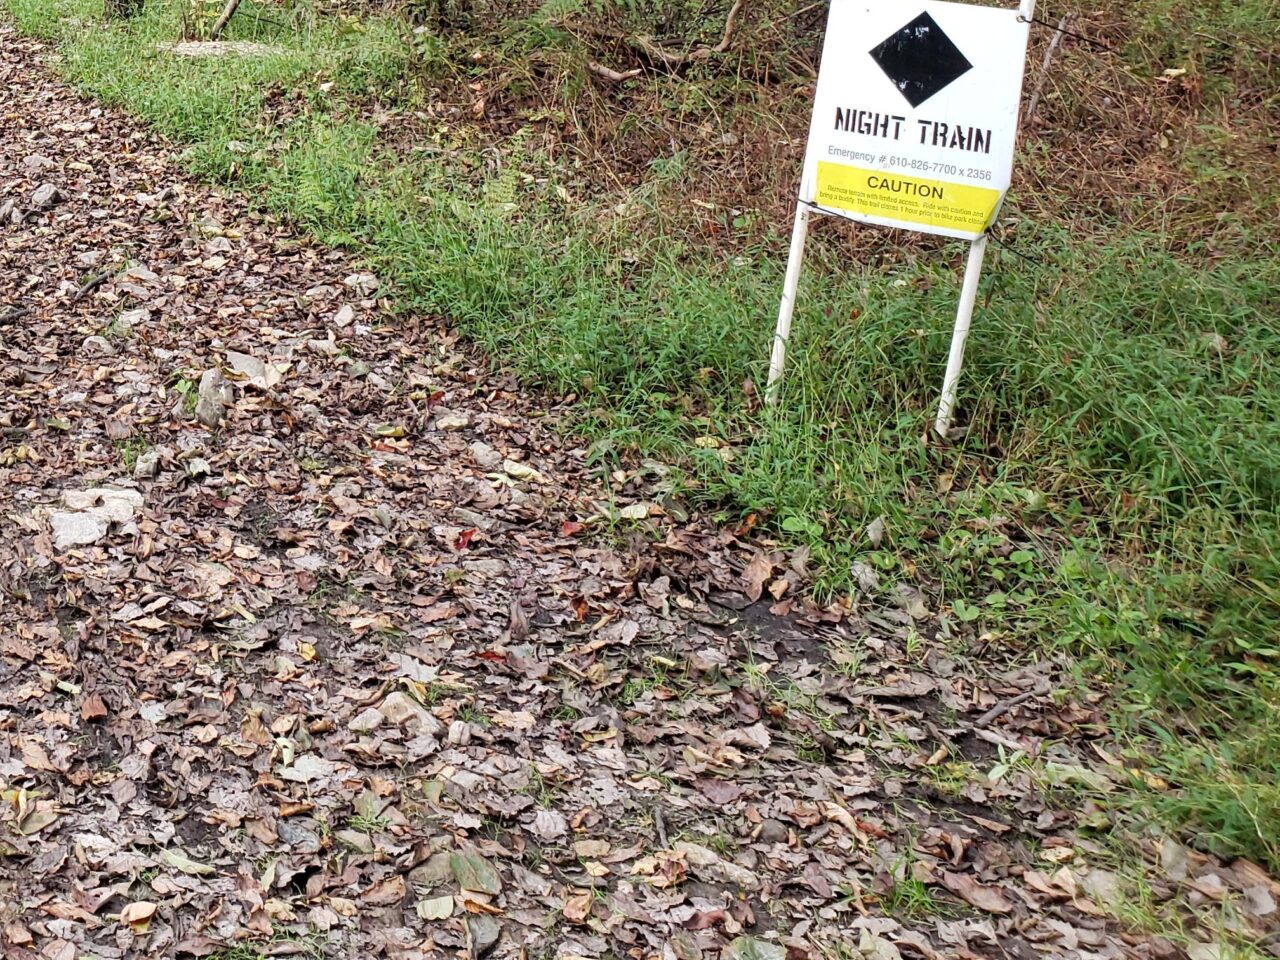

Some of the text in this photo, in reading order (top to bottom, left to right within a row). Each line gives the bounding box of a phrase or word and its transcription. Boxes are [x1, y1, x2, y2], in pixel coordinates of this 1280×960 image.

[834, 107, 992, 154] NIGHT TRAIN
[828, 145, 875, 163] Emergency
[878, 154, 886, 164] #
[889, 155, 956, 175] 610-826-7700
[967, 167, 992, 180] 2356
[819, 191, 833, 200] bring
[867, 176, 944, 200] CAUTION
[879, 194, 897, 203] limited
[937, 204, 949, 212] with
[951, 206, 971, 215] caution
